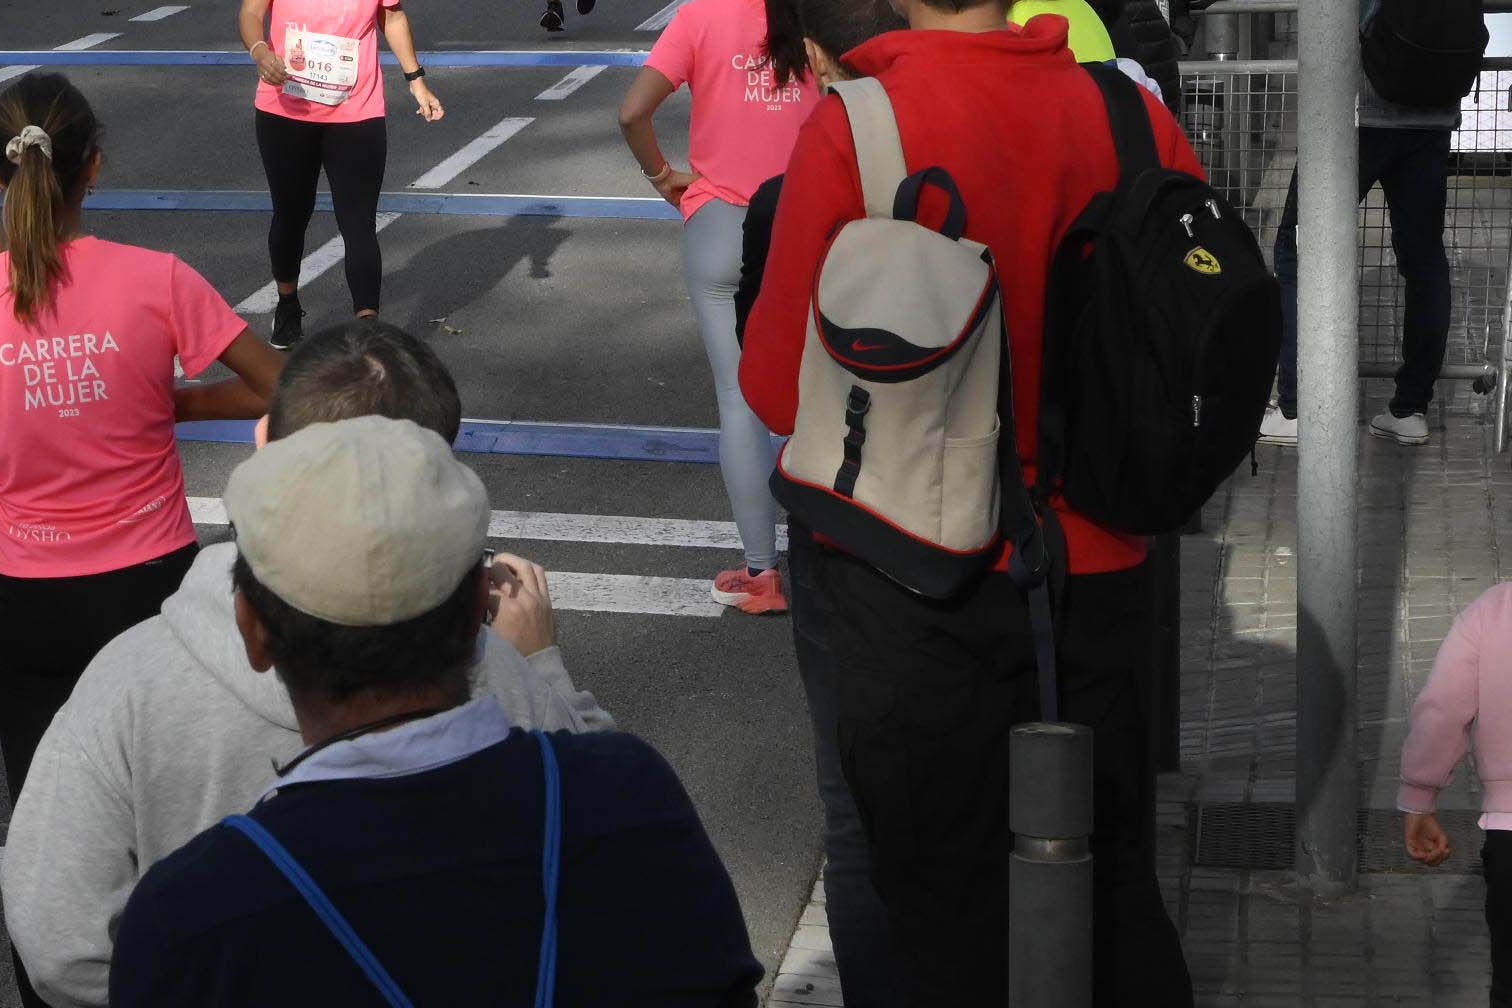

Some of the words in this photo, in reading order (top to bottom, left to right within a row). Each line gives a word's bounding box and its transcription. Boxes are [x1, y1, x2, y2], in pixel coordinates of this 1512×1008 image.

[308, 59, 332, 72] 016
[748, 71, 770, 86] DE
[744, 87, 801, 103] MUJER
[24, 364, 56, 386] DE
[67, 358, 101, 383] LA
[25, 379, 109, 411] MUJER
[59, 408, 80, 418] 2023
